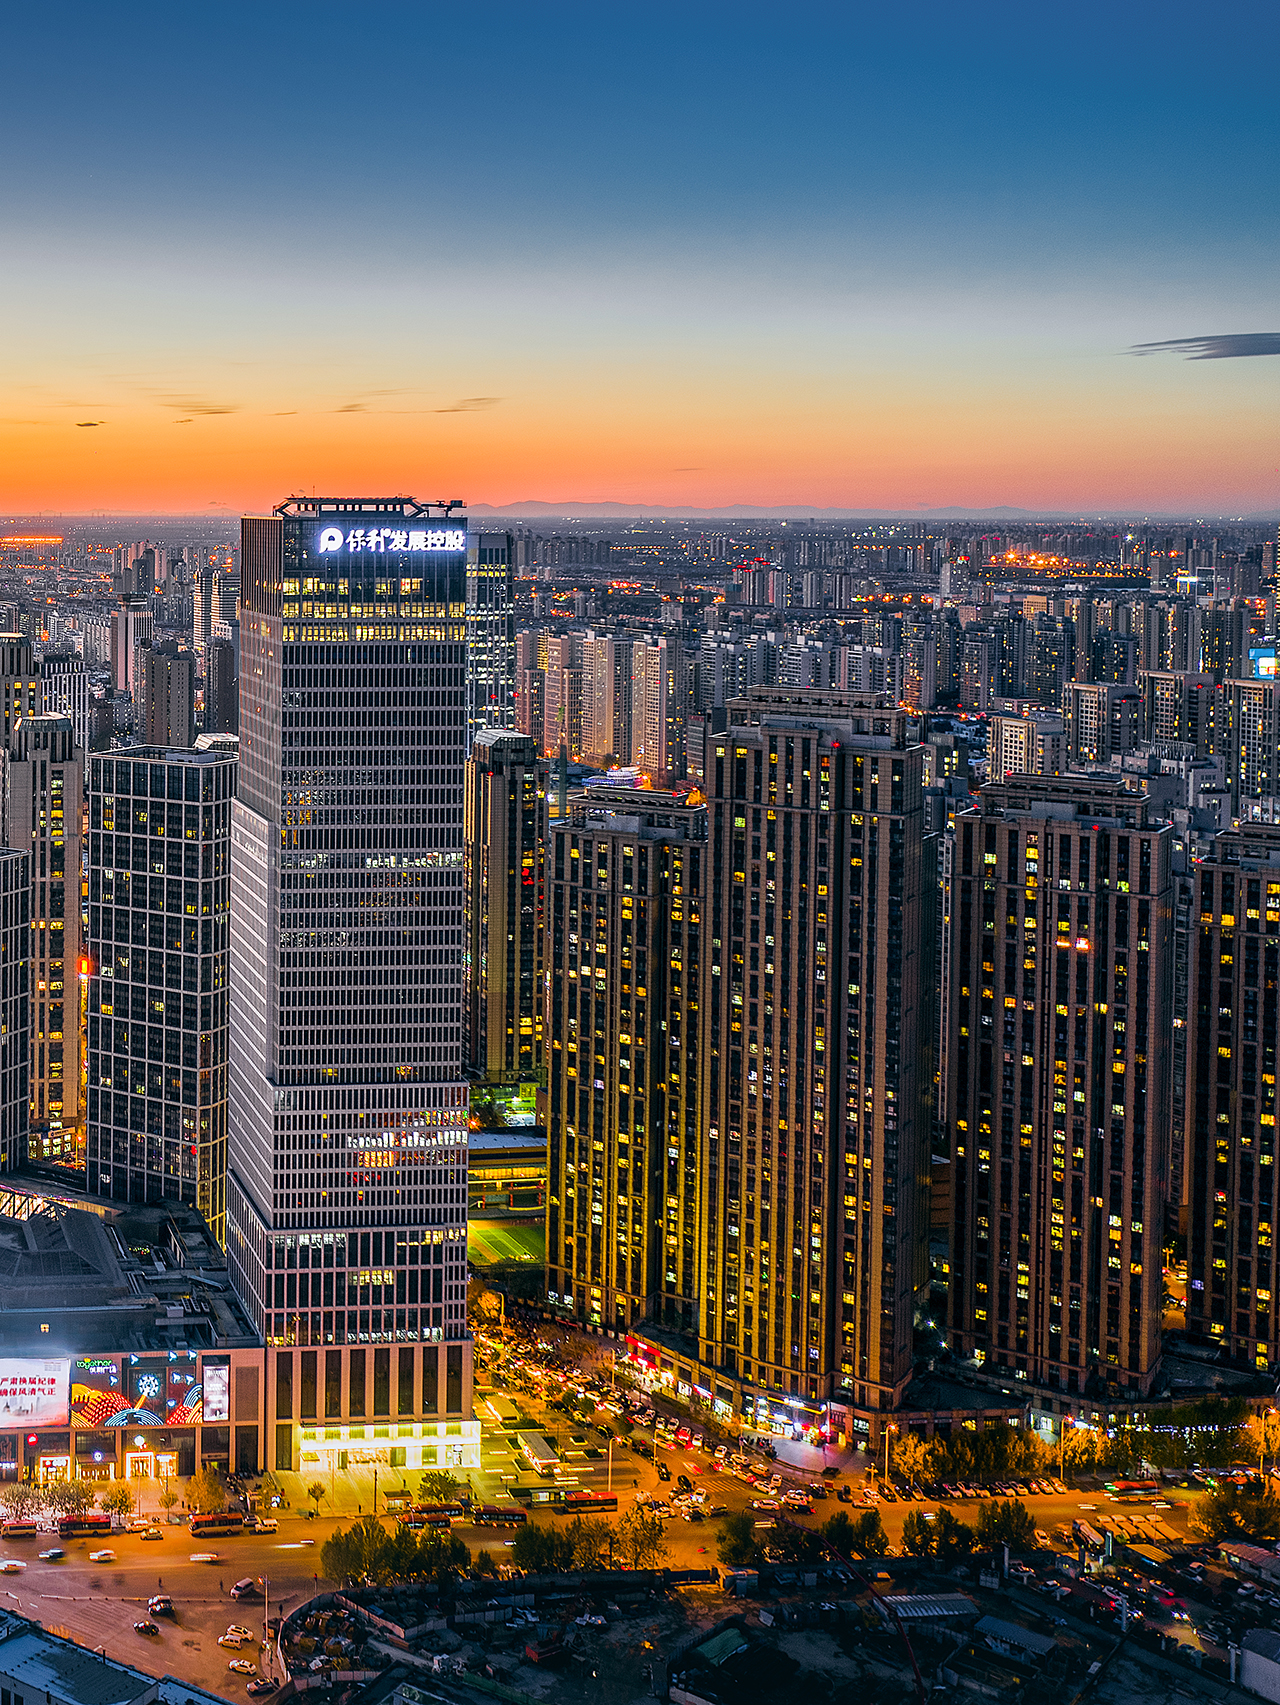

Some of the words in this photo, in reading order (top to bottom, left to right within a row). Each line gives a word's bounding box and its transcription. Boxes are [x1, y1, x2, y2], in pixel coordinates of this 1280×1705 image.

[0, 1377, 57, 1386] 严肃换届纪律
[0, 1387, 57, 1397] 确保风清气正
